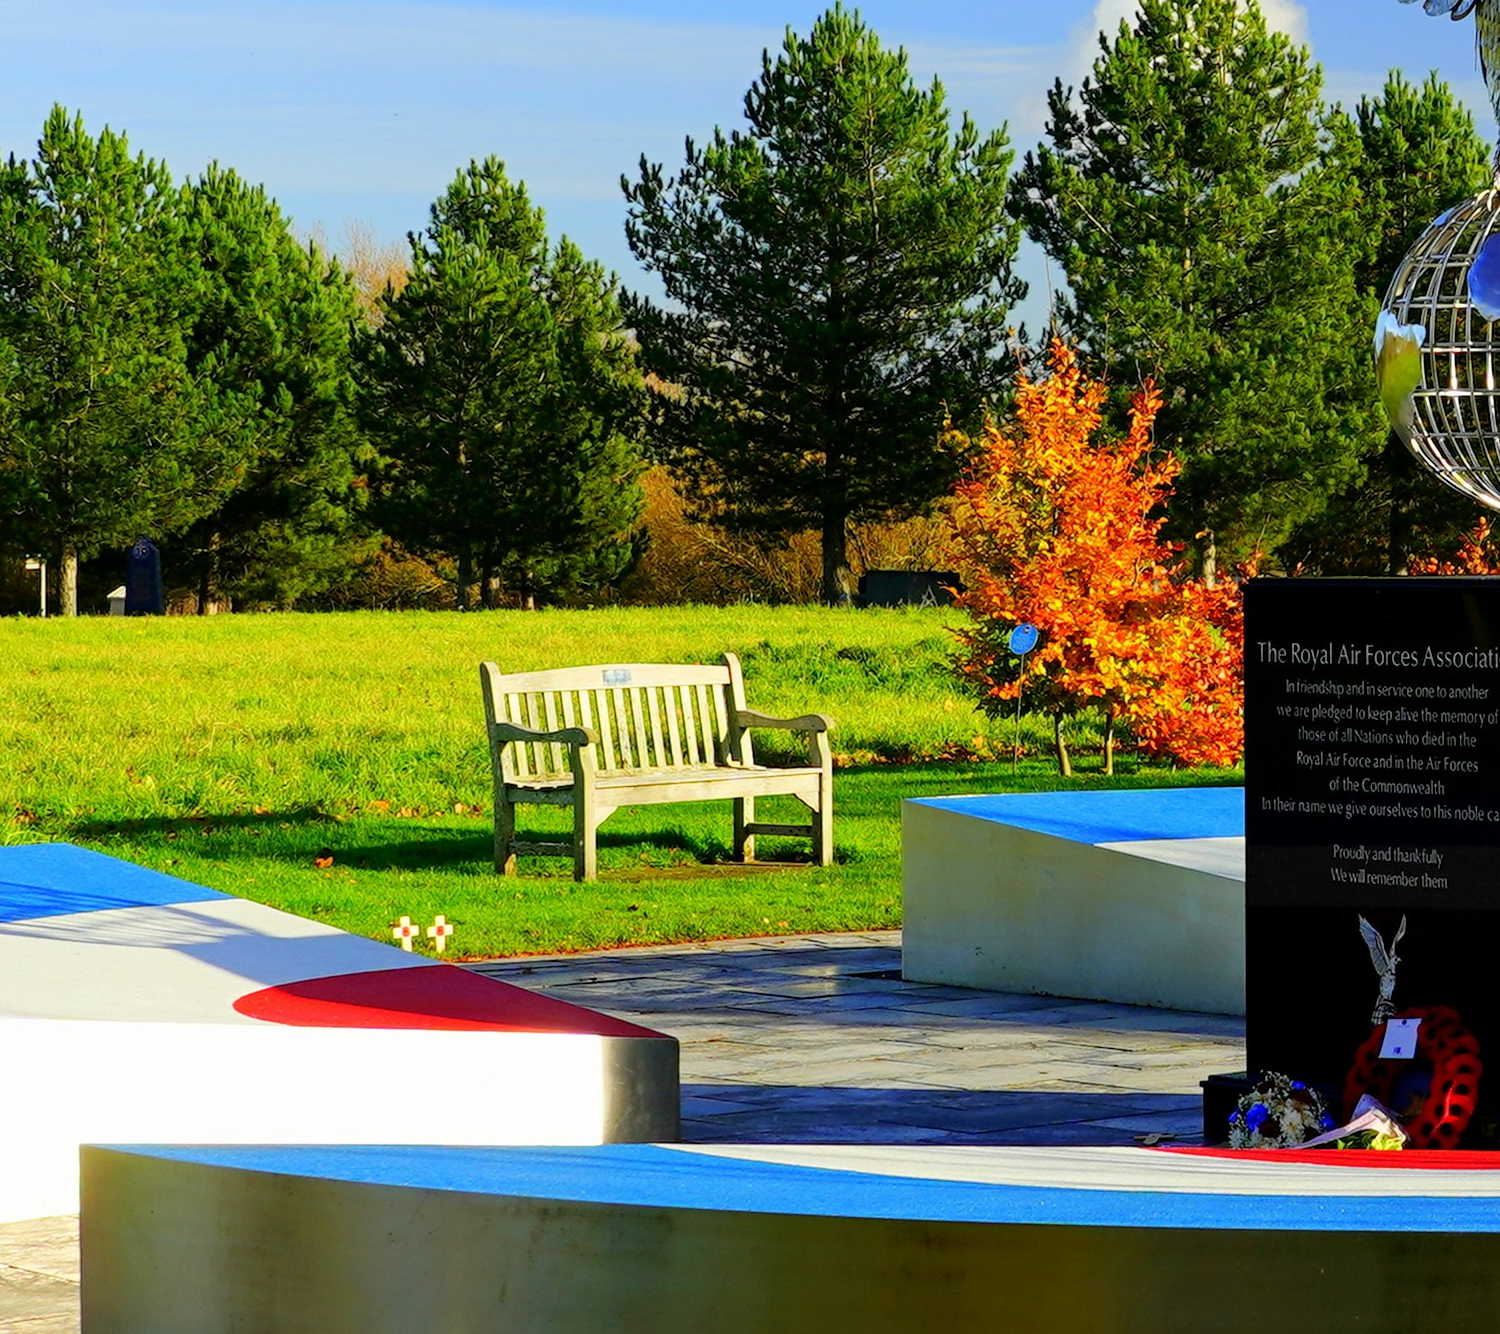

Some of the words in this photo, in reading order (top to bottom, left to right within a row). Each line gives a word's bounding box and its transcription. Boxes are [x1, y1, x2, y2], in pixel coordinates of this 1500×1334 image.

[1257, 641, 1287, 663] The
[1291, 642, 1333, 671] Royal
[1337, 644, 1361, 665] Air
[1365, 644, 1418, 667] Forces
[1286, 679, 1295, 693] In
[1296, 679, 1344, 699] friendship
[1346, 681, 1365, 695] and
[1366, 682, 1376, 695] in
[1377, 683, 1413, 697] service
[1415, 686, 1435, 698] one
[1436, 685, 1447, 698] to
[1449, 684, 1489, 699] another
[1276, 706, 1292, 717] we
[1294, 707, 1310, 718] are
[1312, 703, 1353, 724] pledged
[1355, 707, 1366, 720] to
[1368, 705, 1393, 725] keep
[1395, 706, 1419, 722] alive
[1421, 707, 1438, 723] the
[1440, 712, 1485, 728] memory
[1488, 709, 1499, 725] of
[1298, 726, 1326, 741] those
[1328, 727, 1339, 742] of
[1341, 728, 1353, 742] all
[1354, 729, 1393, 744] Nations
[1395, 730, 1419, 745] who
[1421, 731, 1445, 746] died
[1446, 732, 1457, 747] in
[1459, 732, 1477, 748] the
[1296, 751, 1324, 770] Royal
[1325, 752, 1341, 767] Air
[1342, 753, 1371, 768] Force
[1373, 755, 1393, 769] and
[1394, 755, 1404, 769] in
[1406, 755, 1424, 770] the
[1425, 756, 1442, 771] Air
[1443, 757, 1479, 773] Forces
[1329, 776, 1340, 791] of
[1342, 776, 1360, 792] the
[1361, 778, 1445, 795] Commonwealth
[1262, 796, 1271, 810] In
[1273, 796, 1296, 812] their
[1298, 801, 1326, 814] name
[1327, 803, 1343, 815] we
[1345, 801, 1367, 820] give
[1369, 802, 1419, 818] ourselves
[1421, 805, 1432, 819] to
[1434, 804, 1452, 820] this
[1454, 805, 1484, 821] noble
[1333, 844, 1370, 864] Proudly
[1372, 847, 1392, 862] and
[1393, 847, 1444, 869] thankfully
[1331, 868, 1348, 883] We
[1349, 869, 1366, 884] will
[1367, 871, 1419, 887] remember
[1421, 873, 1448, 889] them
